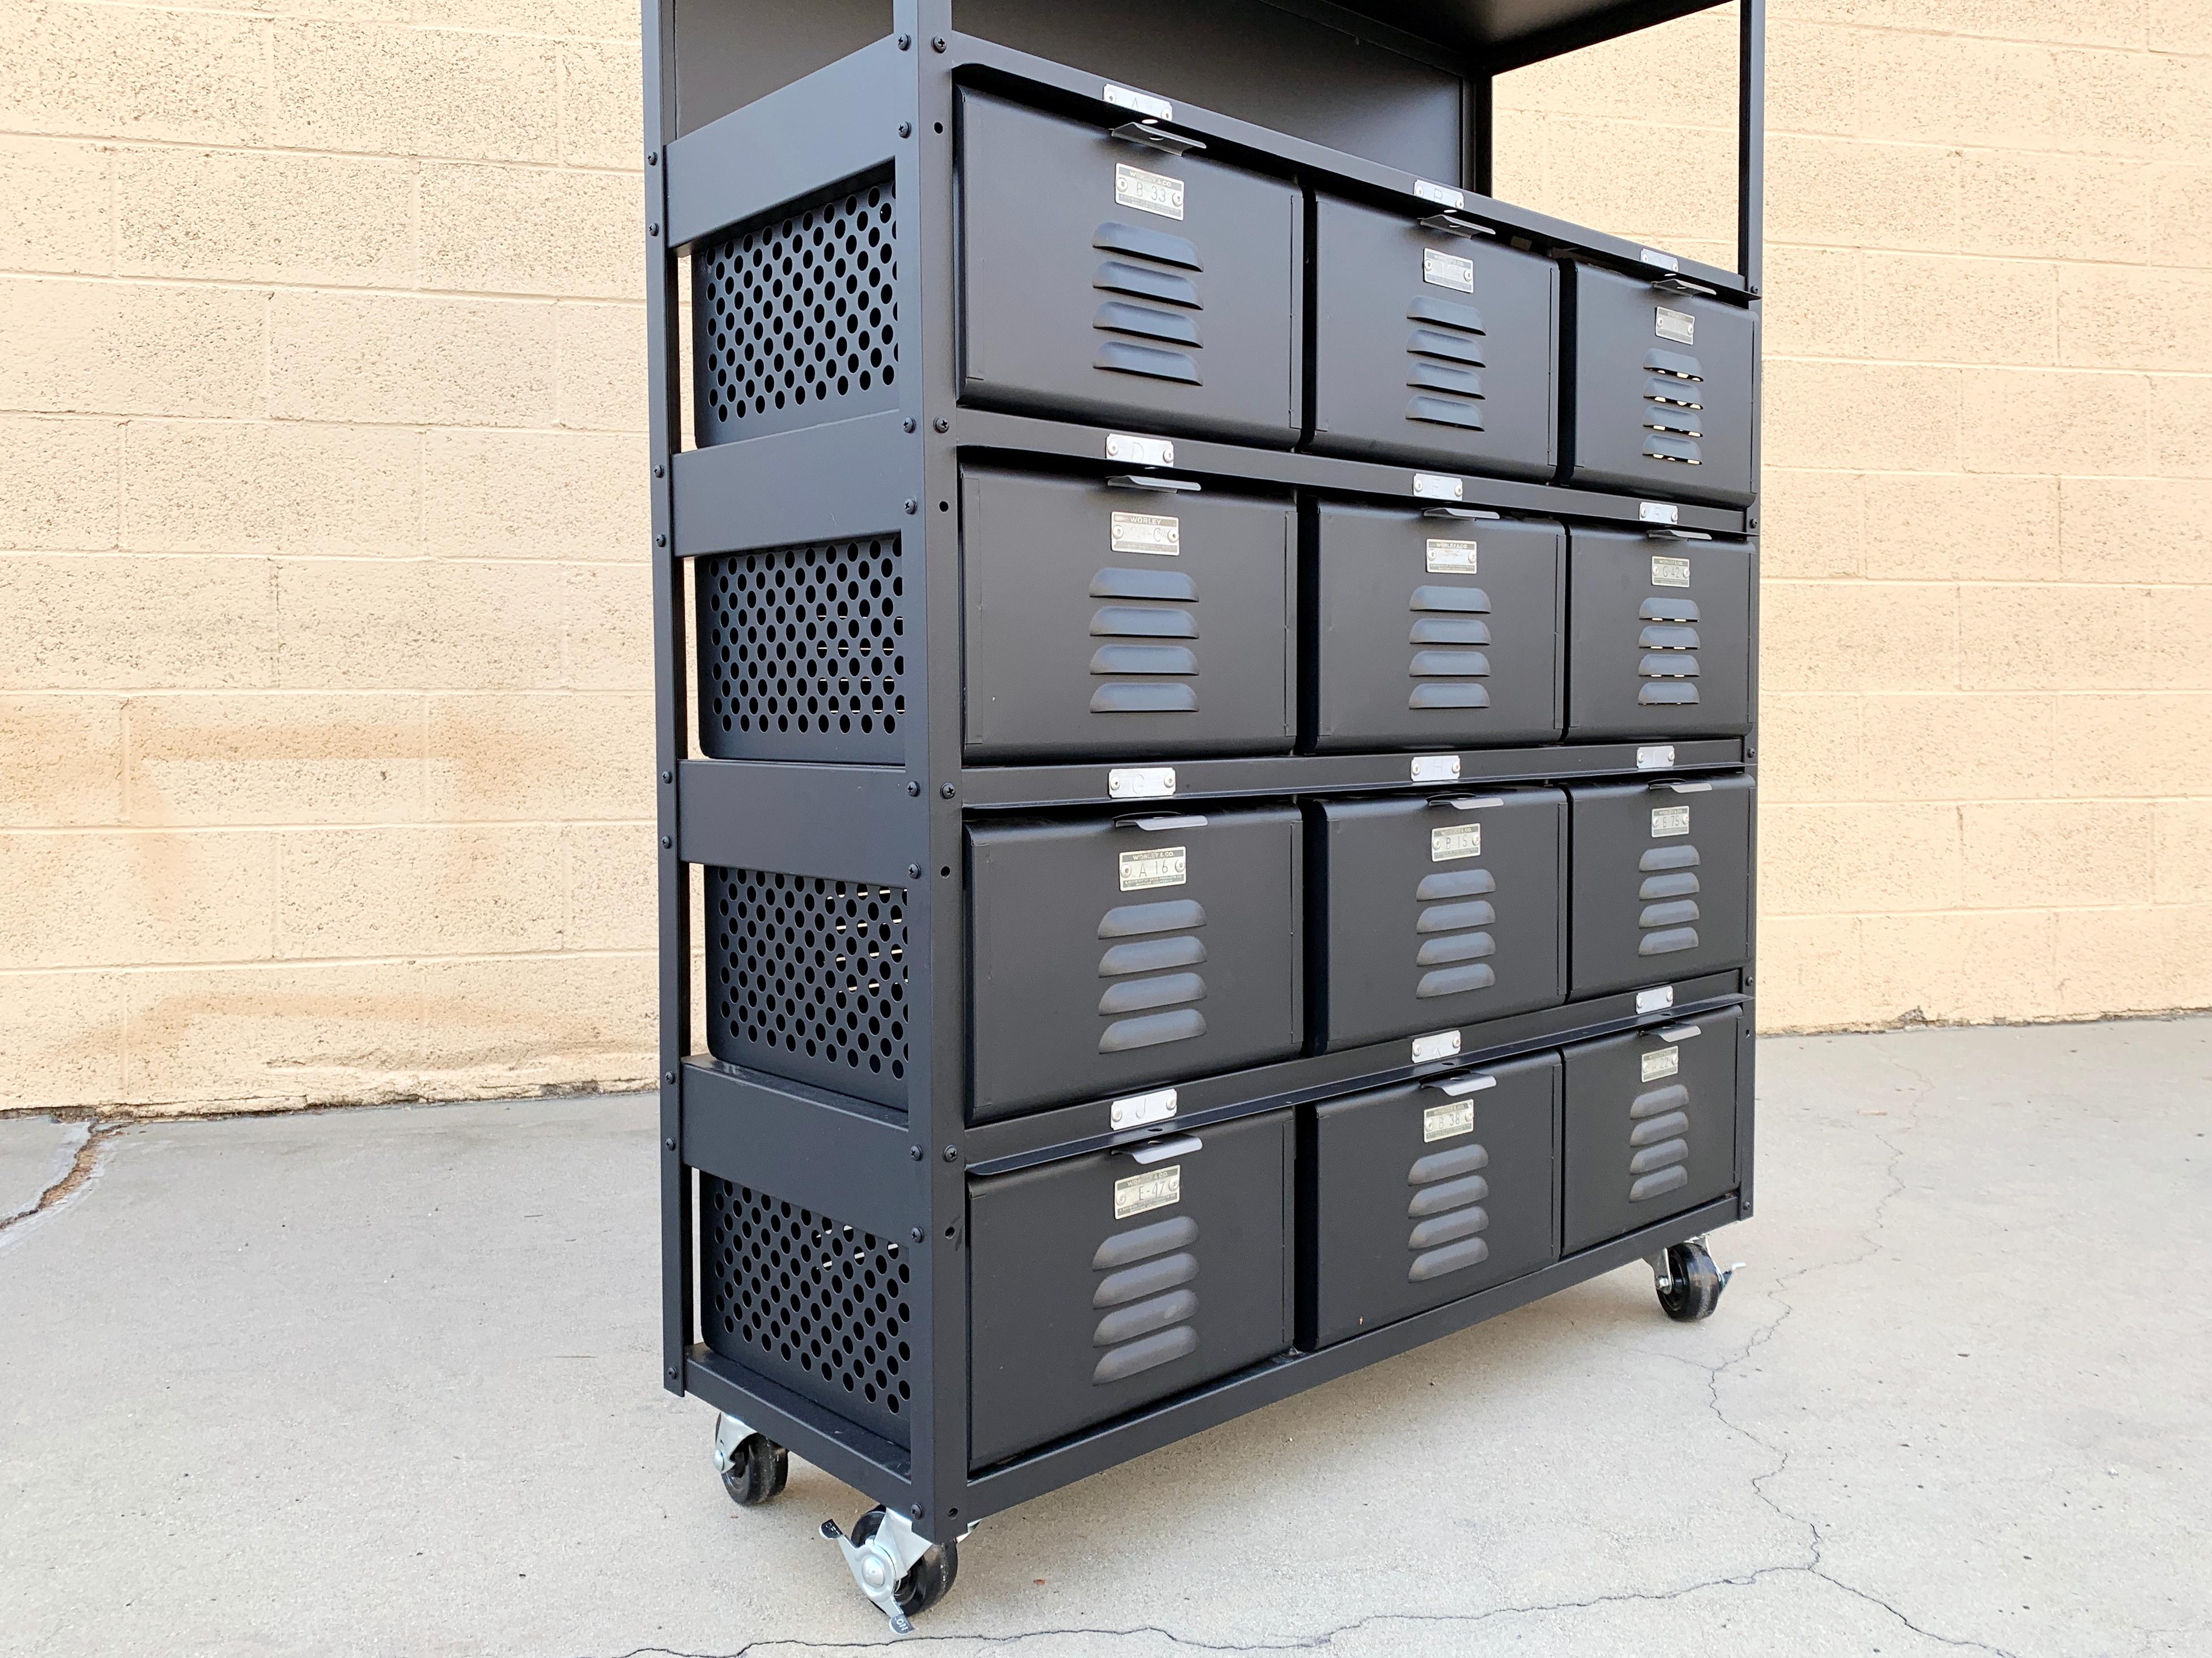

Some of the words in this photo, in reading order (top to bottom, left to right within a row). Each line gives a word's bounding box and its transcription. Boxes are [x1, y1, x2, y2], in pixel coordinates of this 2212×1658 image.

[1137, 182, 1143, 197] B
[1151, 186, 1166, 202] 33
[1667, 311, 1685, 321] WOEY
[1130, 516, 1161, 525] WORLEY
[1671, 815, 1679, 826] 75
[1446, 837, 1451, 850] B
[1458, 834, 1467, 848] 15
[1132, 852, 1160, 861] WORLEY
[1139, 863, 1147, 878] A
[1155, 860, 1168, 875] 16
[1449, 1112, 1460, 1126] 38
[897, 1618, 908, 1631] ON
